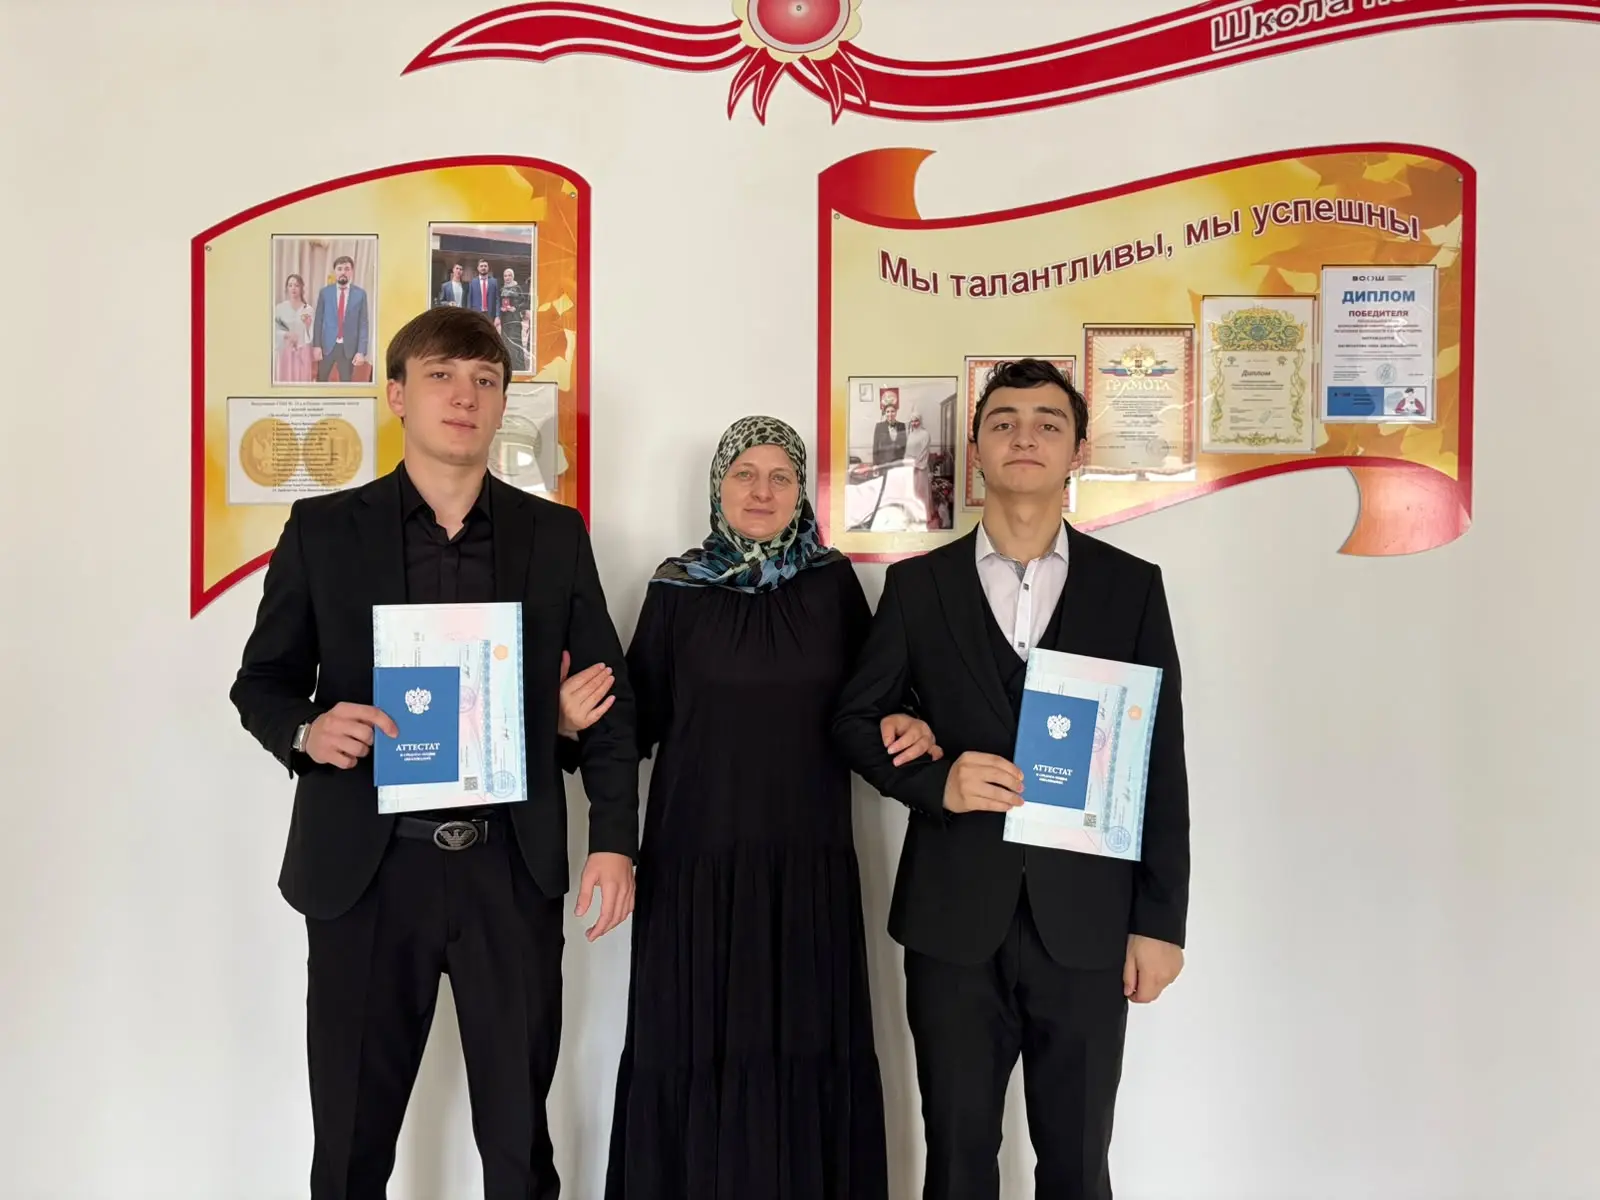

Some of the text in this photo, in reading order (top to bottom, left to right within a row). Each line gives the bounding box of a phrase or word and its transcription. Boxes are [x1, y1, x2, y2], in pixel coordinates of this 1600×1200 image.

[1211, 0, 1353, 51] Школа
[879, 198, 1420, 298] Мы талантливы, мы успешны
[1342, 290, 1416, 304] ДИПЛОМ
[1348, 310, 1409, 318] ПОБЕДИТЕЛЯ
[1241, 369, 1271, 378] Диплом
[1105, 379, 1172, 391] ГРАМОТА
[396, 742, 441, 751] АТТЕСТАТ
[1033, 764, 1073, 776] АТТЕСТАТ
